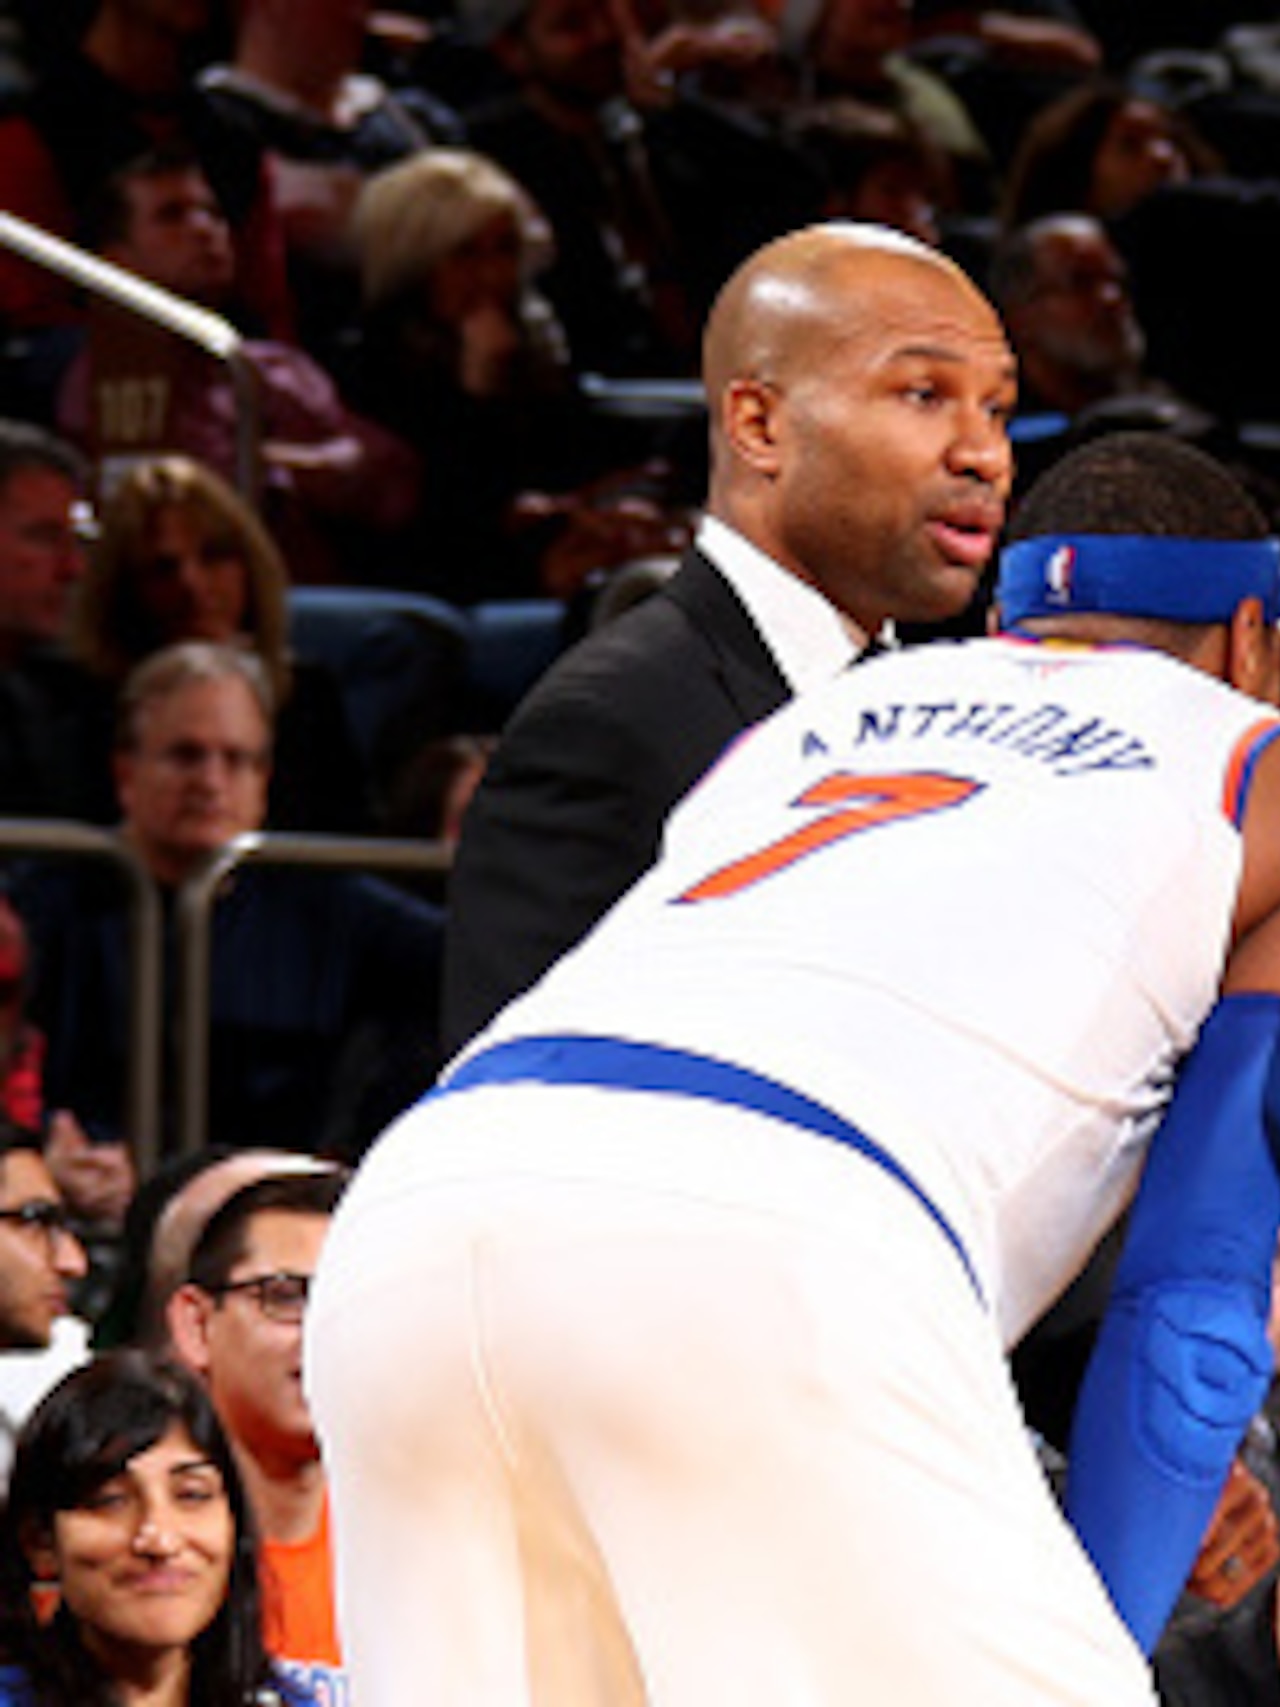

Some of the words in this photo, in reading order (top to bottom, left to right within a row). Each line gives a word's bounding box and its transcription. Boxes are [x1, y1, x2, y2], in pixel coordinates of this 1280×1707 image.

[98, 377, 170, 442] 107
[801, 701, 1156, 777] ANTHONY
[667, 771, 989, 905] 7
